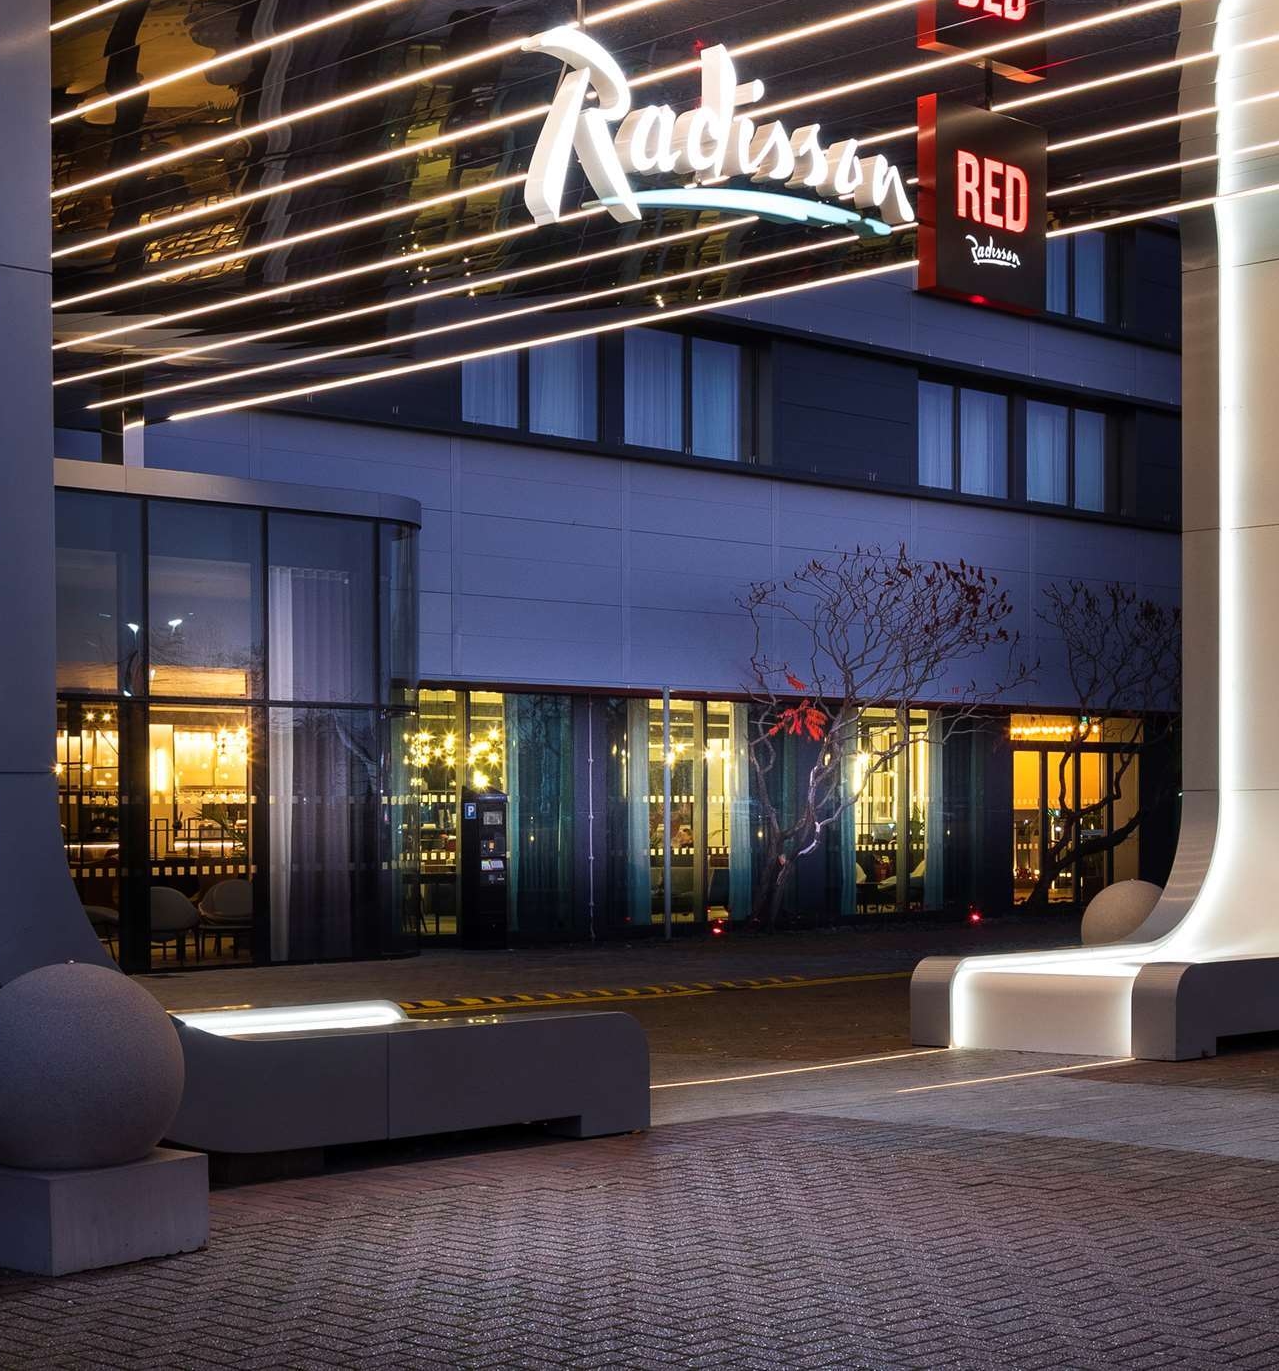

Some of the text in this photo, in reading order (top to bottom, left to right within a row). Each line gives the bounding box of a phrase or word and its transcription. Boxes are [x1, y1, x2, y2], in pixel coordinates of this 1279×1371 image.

[521, 27, 915, 227] Radisson
[956, 149, 1029, 233] RED
[965, 234, 1021, 269] Radisson
